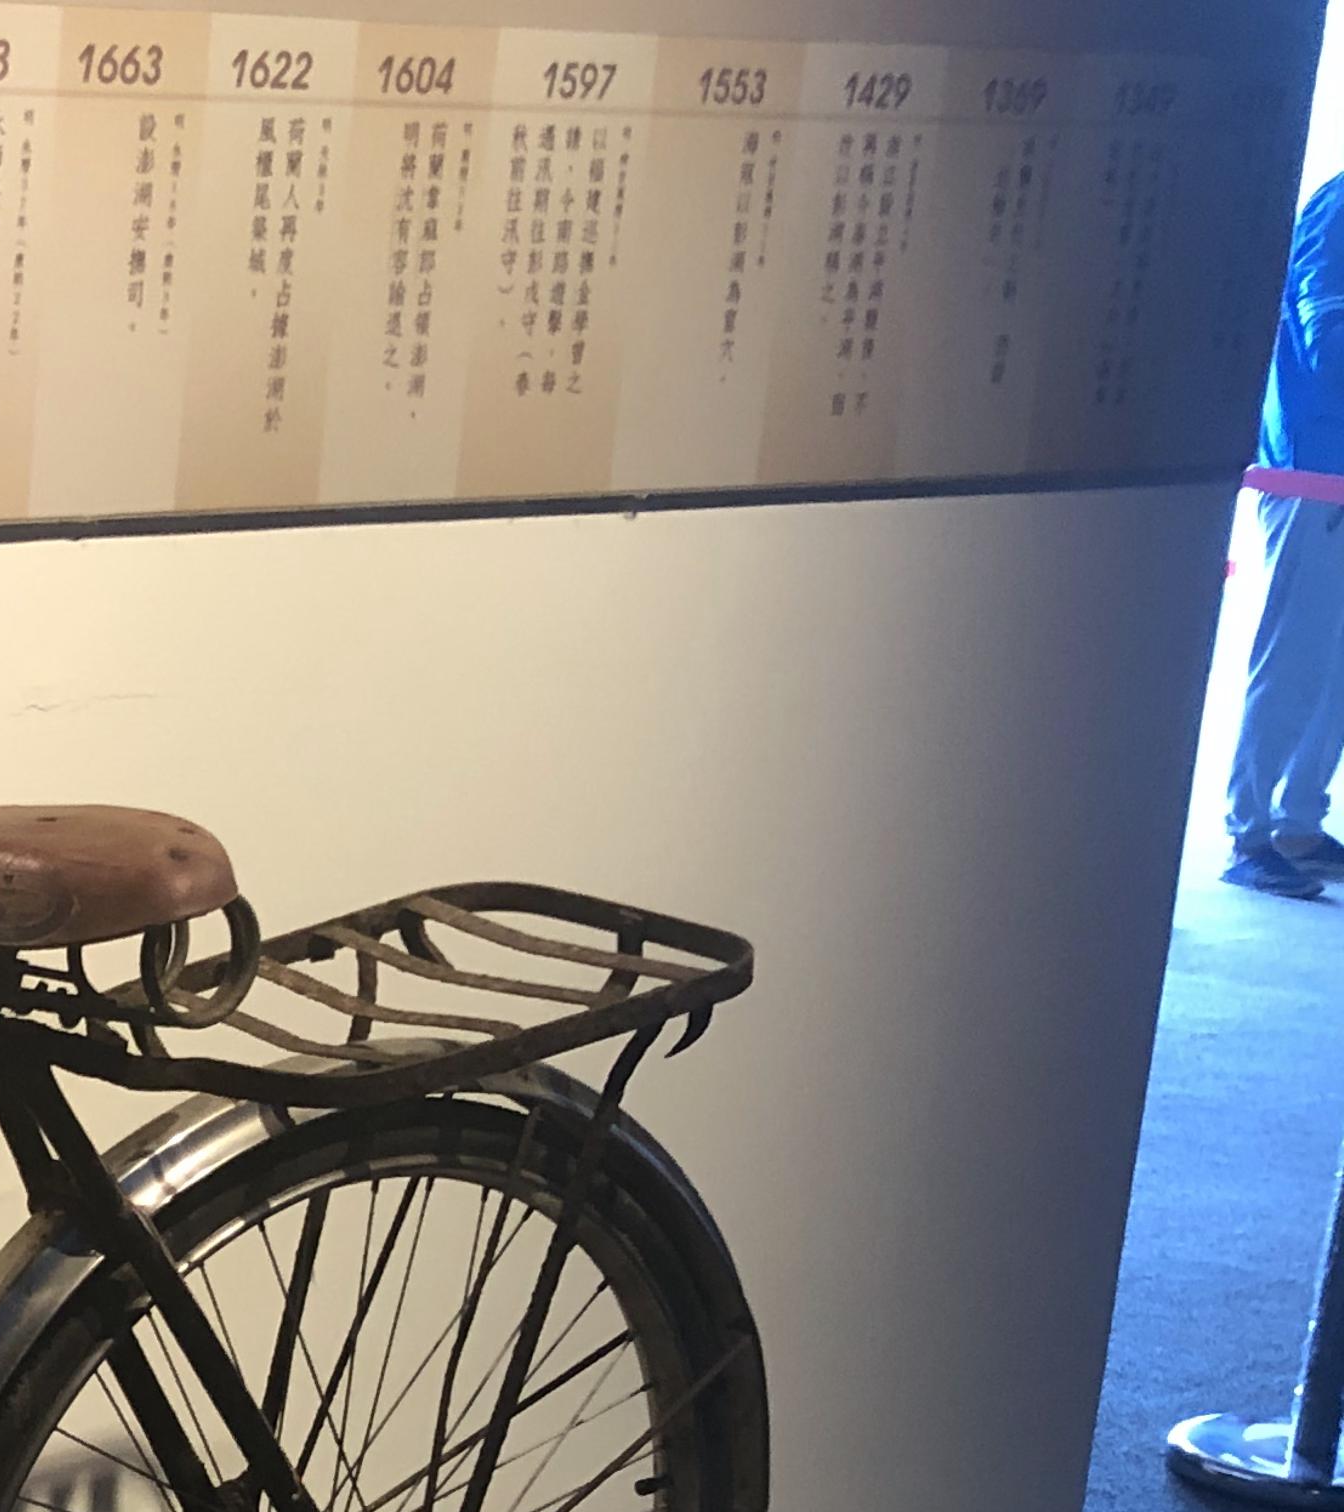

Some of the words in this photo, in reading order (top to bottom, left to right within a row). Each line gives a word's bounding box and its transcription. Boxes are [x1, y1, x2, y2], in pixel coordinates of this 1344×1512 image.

[78, 43, 164, 86] 1663
[232, 48, 314, 90] 1622
[378, 55, 456, 95] 1604
[543, 61, 617, 100] 1597
[699, 67, 767, 105] 1553
[844, 71, 913, 110] 1429
